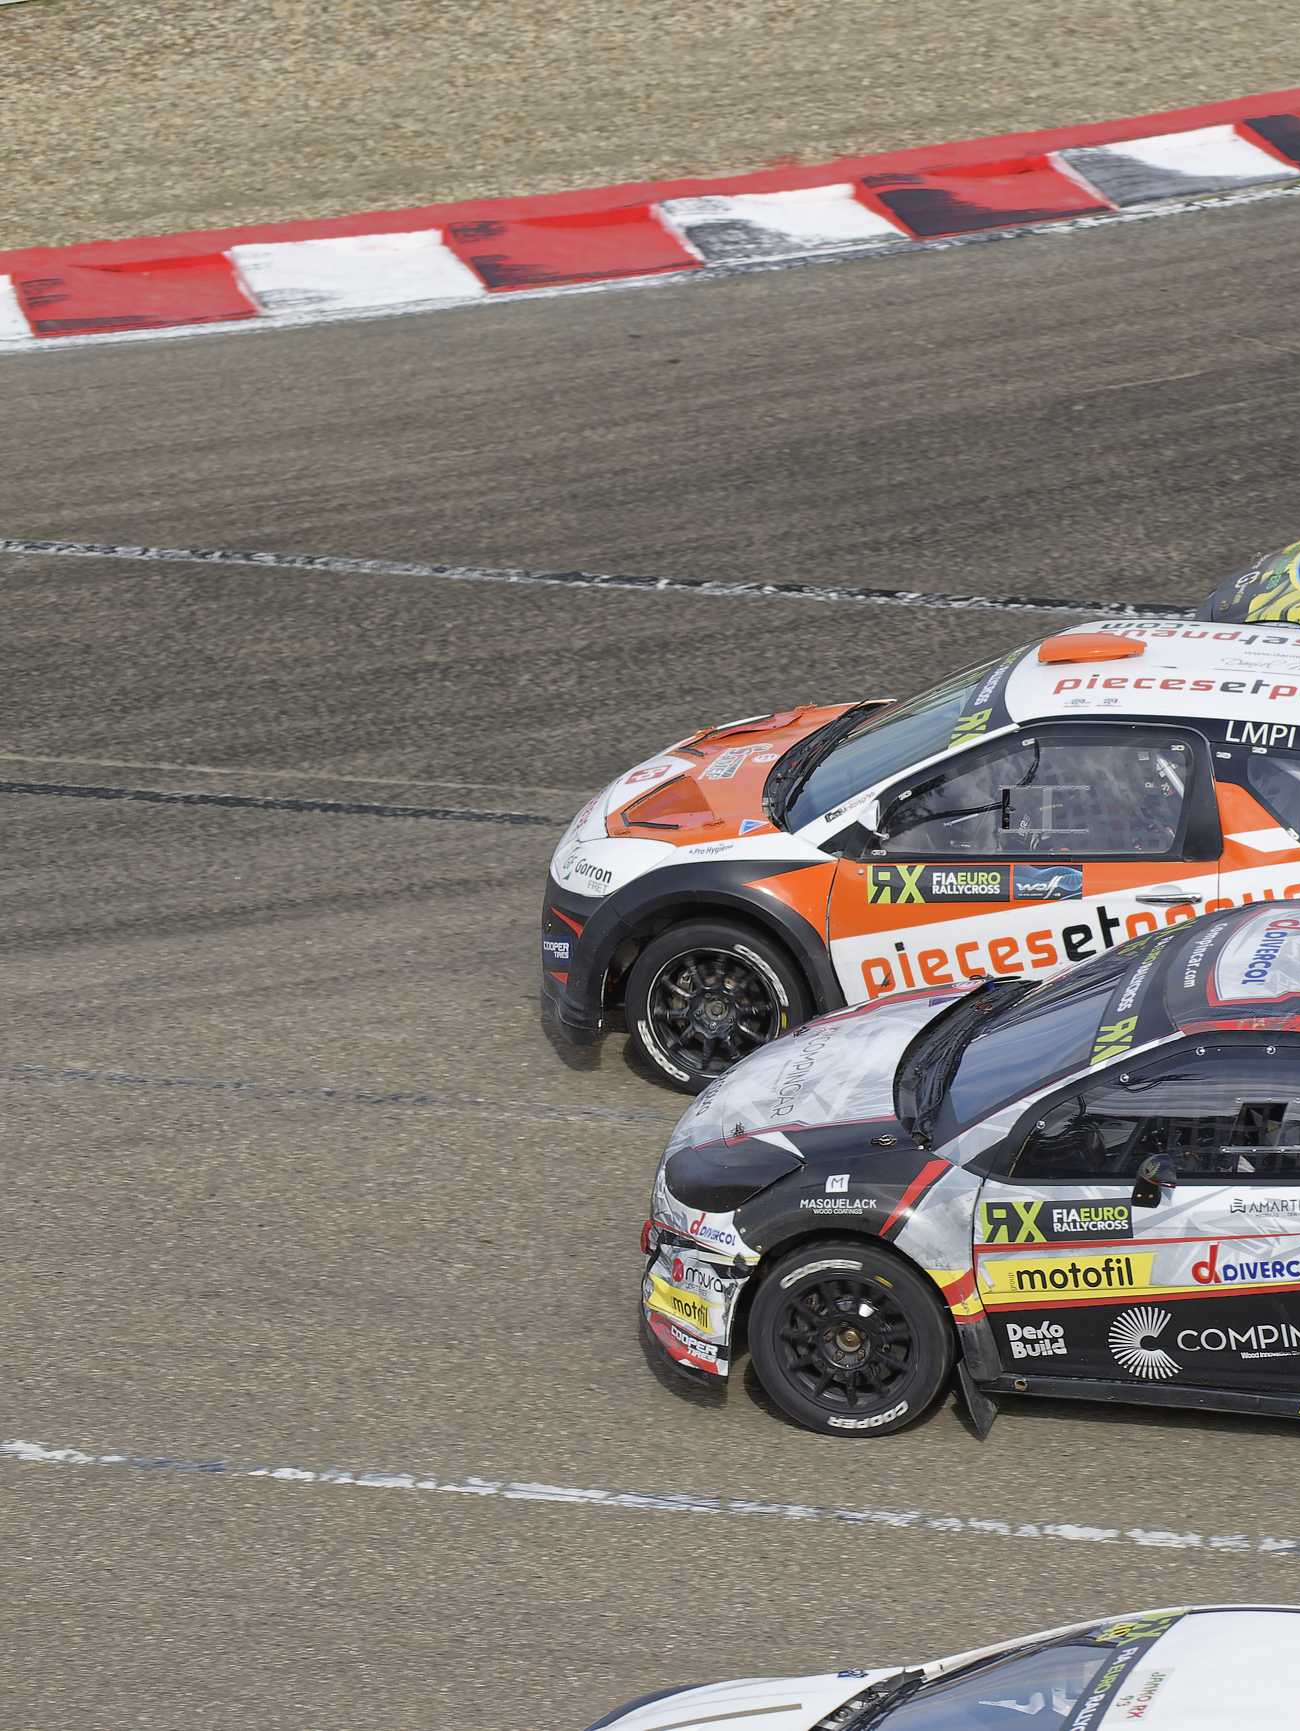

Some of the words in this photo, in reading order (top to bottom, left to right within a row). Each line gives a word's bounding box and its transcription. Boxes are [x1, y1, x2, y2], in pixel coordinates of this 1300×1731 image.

[1225, 720, 1297, 748] LMPI
[575, 858, 612, 885] Gorron
[932, 884, 1001, 895] RALLYCROSS
[543, 941, 570, 952] COOPER
[800, 1199, 877, 1209] MASQUELACK
[1053, 1220, 1129, 1233] RALLYCROSS
[1016, 1257, 1134, 1290] motofil
[1009, 1338, 1069, 1359] Build
